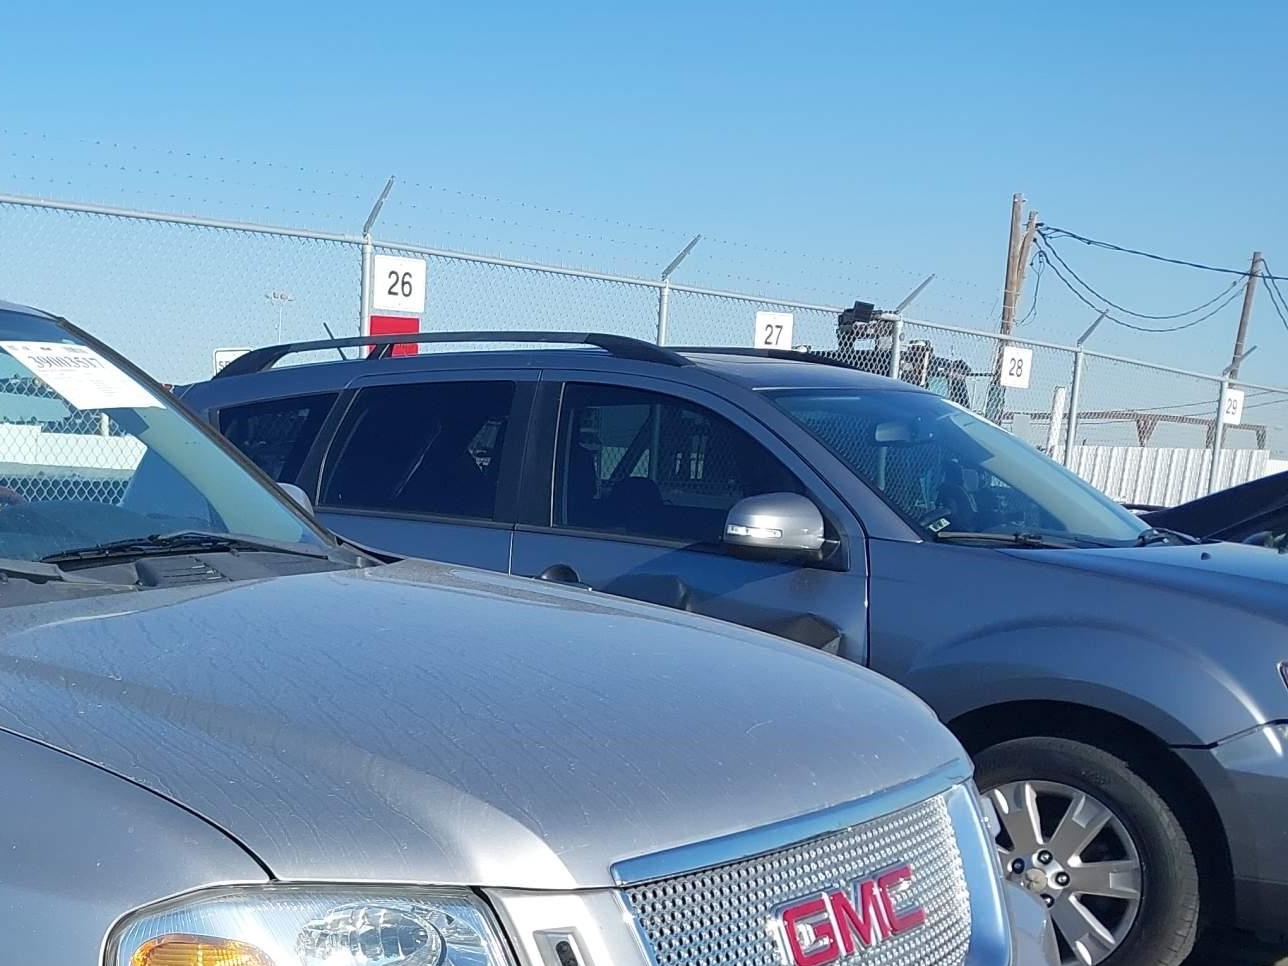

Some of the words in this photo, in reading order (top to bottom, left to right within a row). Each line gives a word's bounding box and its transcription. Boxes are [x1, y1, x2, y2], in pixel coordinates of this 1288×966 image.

[387, 270, 413, 297] 26
[764, 323, 784, 346] 27
[1008, 357, 1024, 378] 28
[1225, 397, 1238, 416] 29
